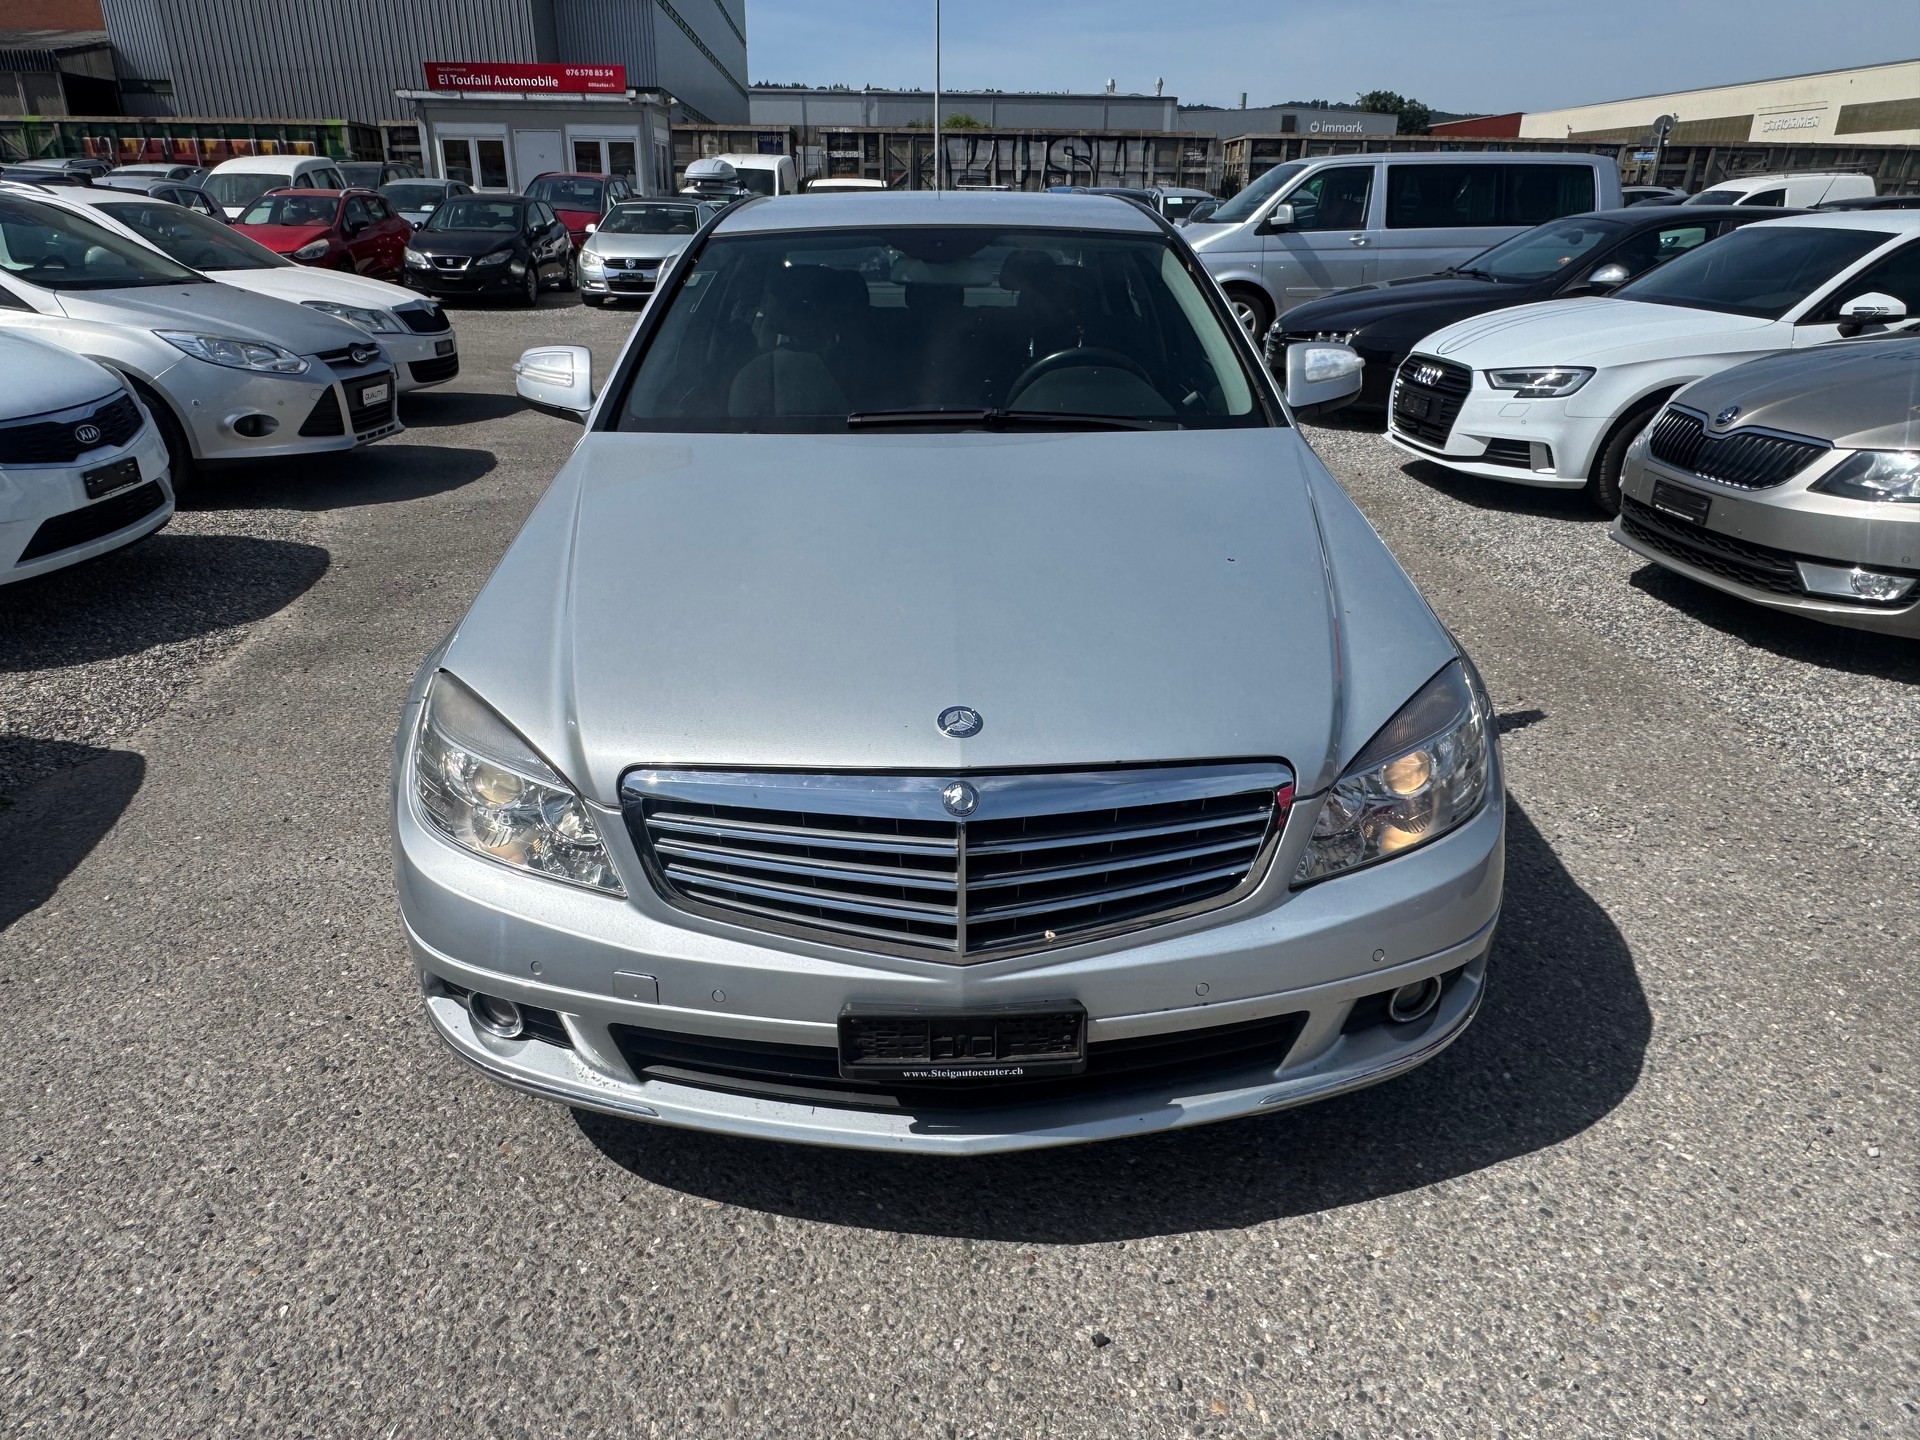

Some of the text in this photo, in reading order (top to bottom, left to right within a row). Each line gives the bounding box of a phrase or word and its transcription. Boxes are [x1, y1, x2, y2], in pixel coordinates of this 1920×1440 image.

[565, 68, 579, 77] 076
[438, 74, 449, 85] El
[494, 76, 559, 87] Automobile
[1322, 121, 1363, 133] immark
[758, 134, 783, 143] cargo
[903, 1067, 1024, 1079] www.Steigautocenter.ch
